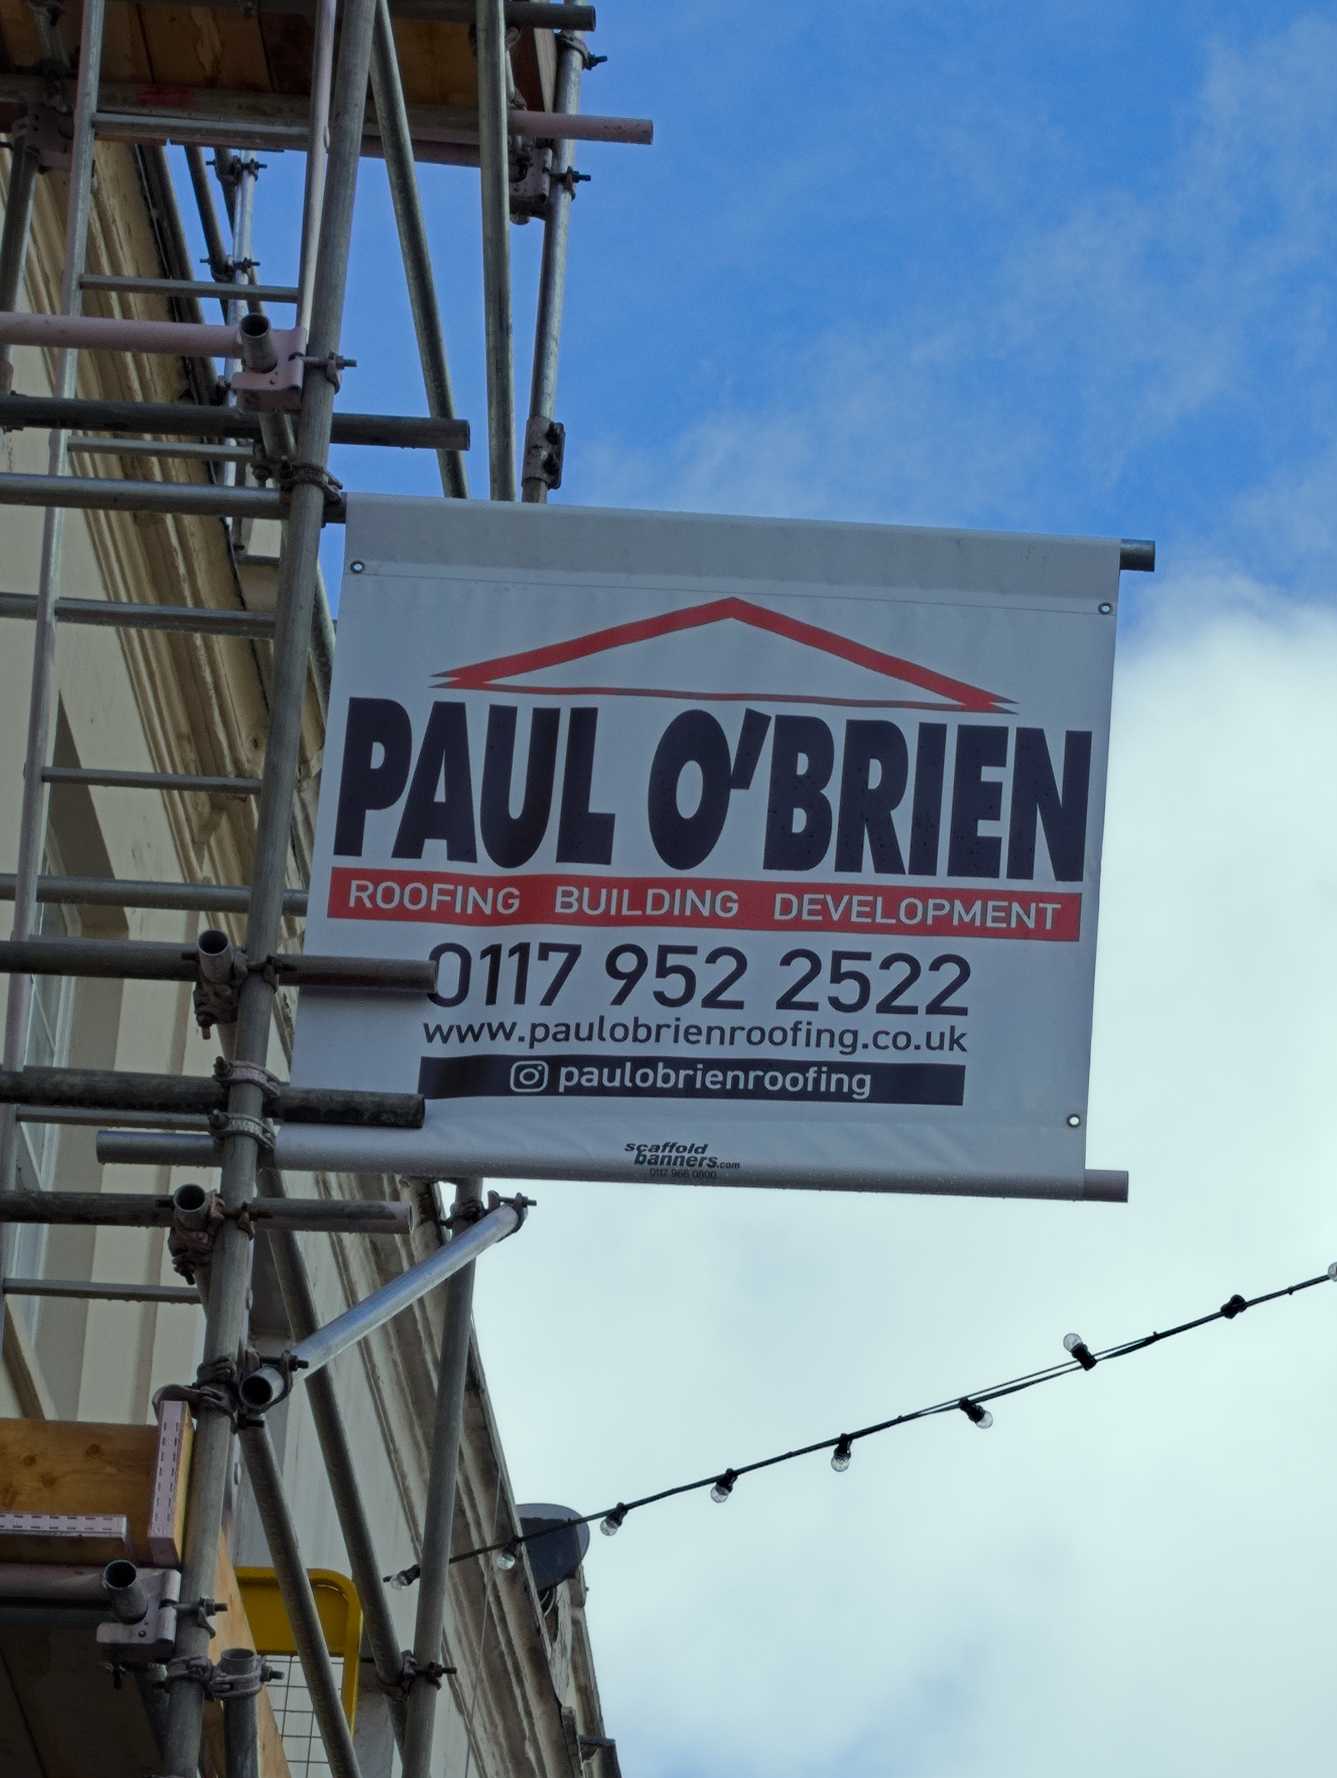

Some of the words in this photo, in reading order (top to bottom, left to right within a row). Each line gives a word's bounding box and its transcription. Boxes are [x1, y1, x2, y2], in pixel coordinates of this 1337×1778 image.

[334, 697, 615, 868] PAUL
[649, 708, 1092, 881] O'BRIEN
[348, 880, 520, 916] ROOFING
[555, 886, 739, 918] BUILDING
[775, 893, 1061, 930] DEVELOPMENT
[430, 941, 581, 1007] 0117
[606, 944, 747, 1010] 952
[778, 949, 971, 1016] 2522
[423, 1017, 968, 1055] www.paulobrienroofing.co.uk
[559, 1062, 871, 1099] paulobrienroofing
[624, 1142, 708, 1154] scaffold
[634, 1152, 740, 1168] banners.com
